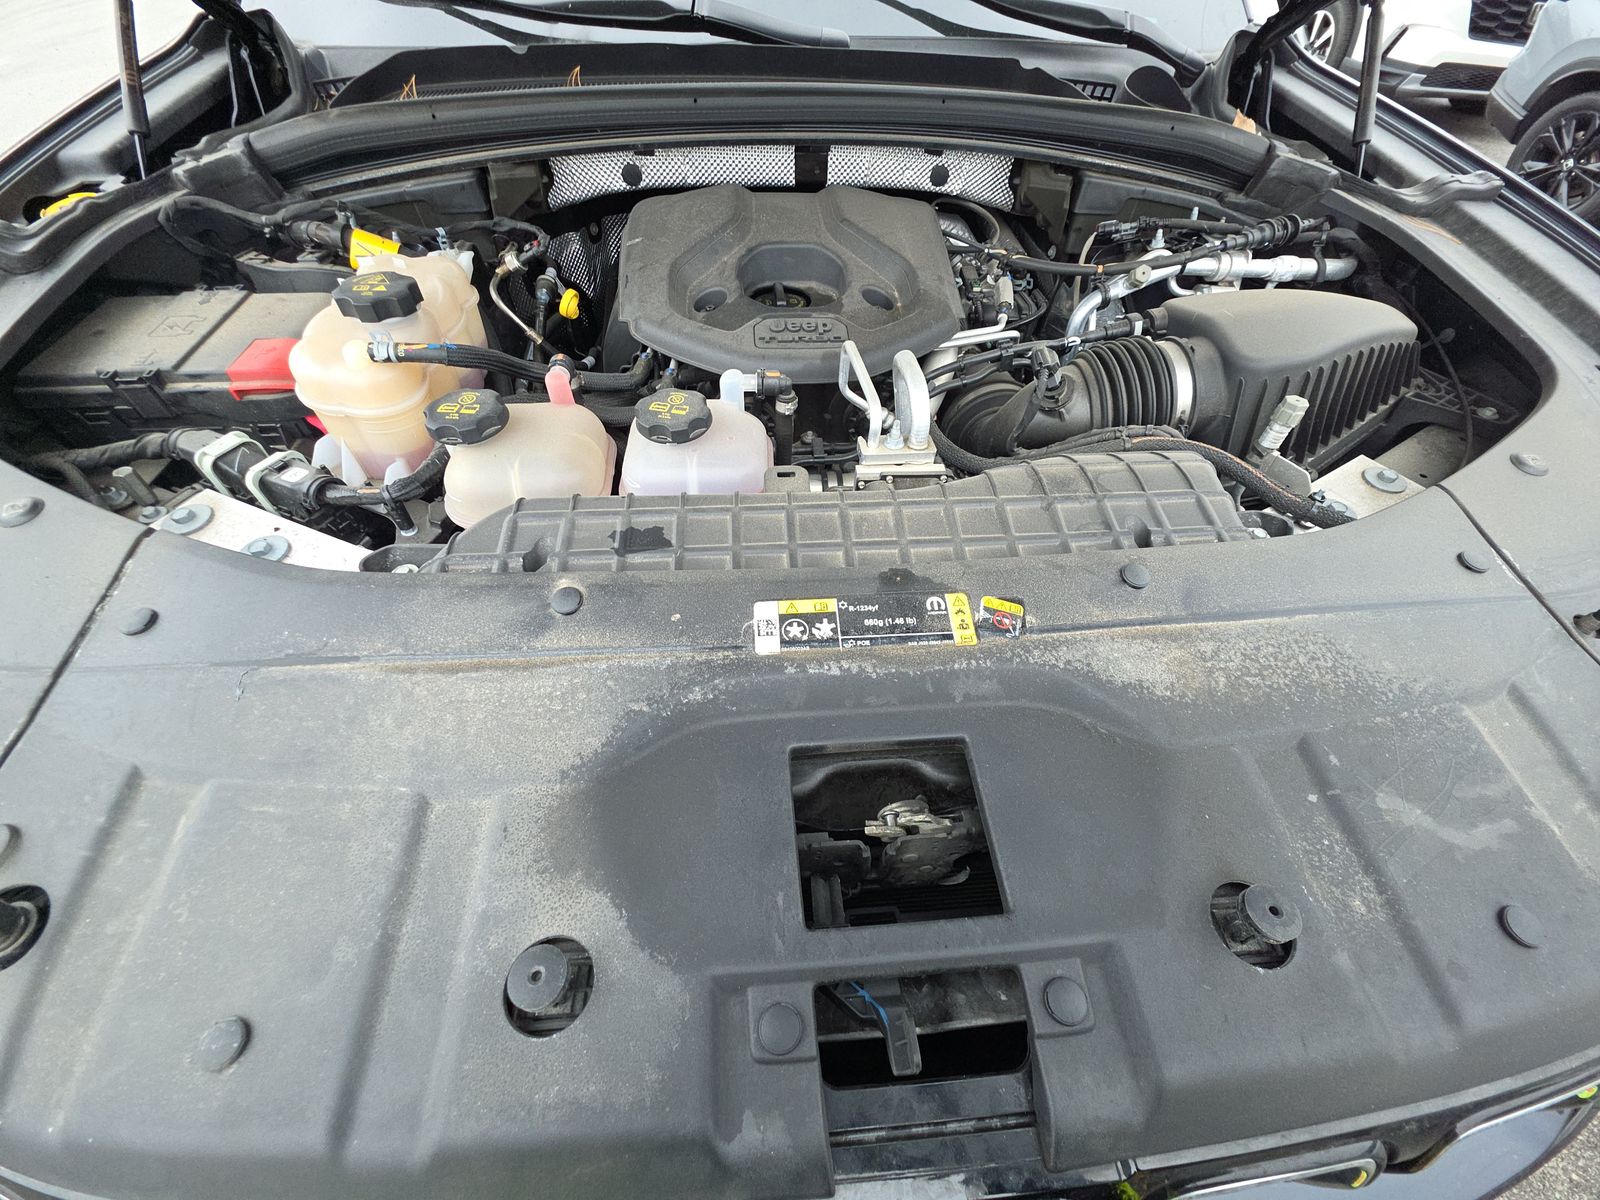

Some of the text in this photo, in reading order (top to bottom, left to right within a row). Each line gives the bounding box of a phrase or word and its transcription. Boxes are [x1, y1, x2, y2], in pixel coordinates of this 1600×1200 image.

[769, 319, 833, 335] Jeep
[849, 604, 879, 613] R-1234yf
[905, 616, 917, 626] lb)
